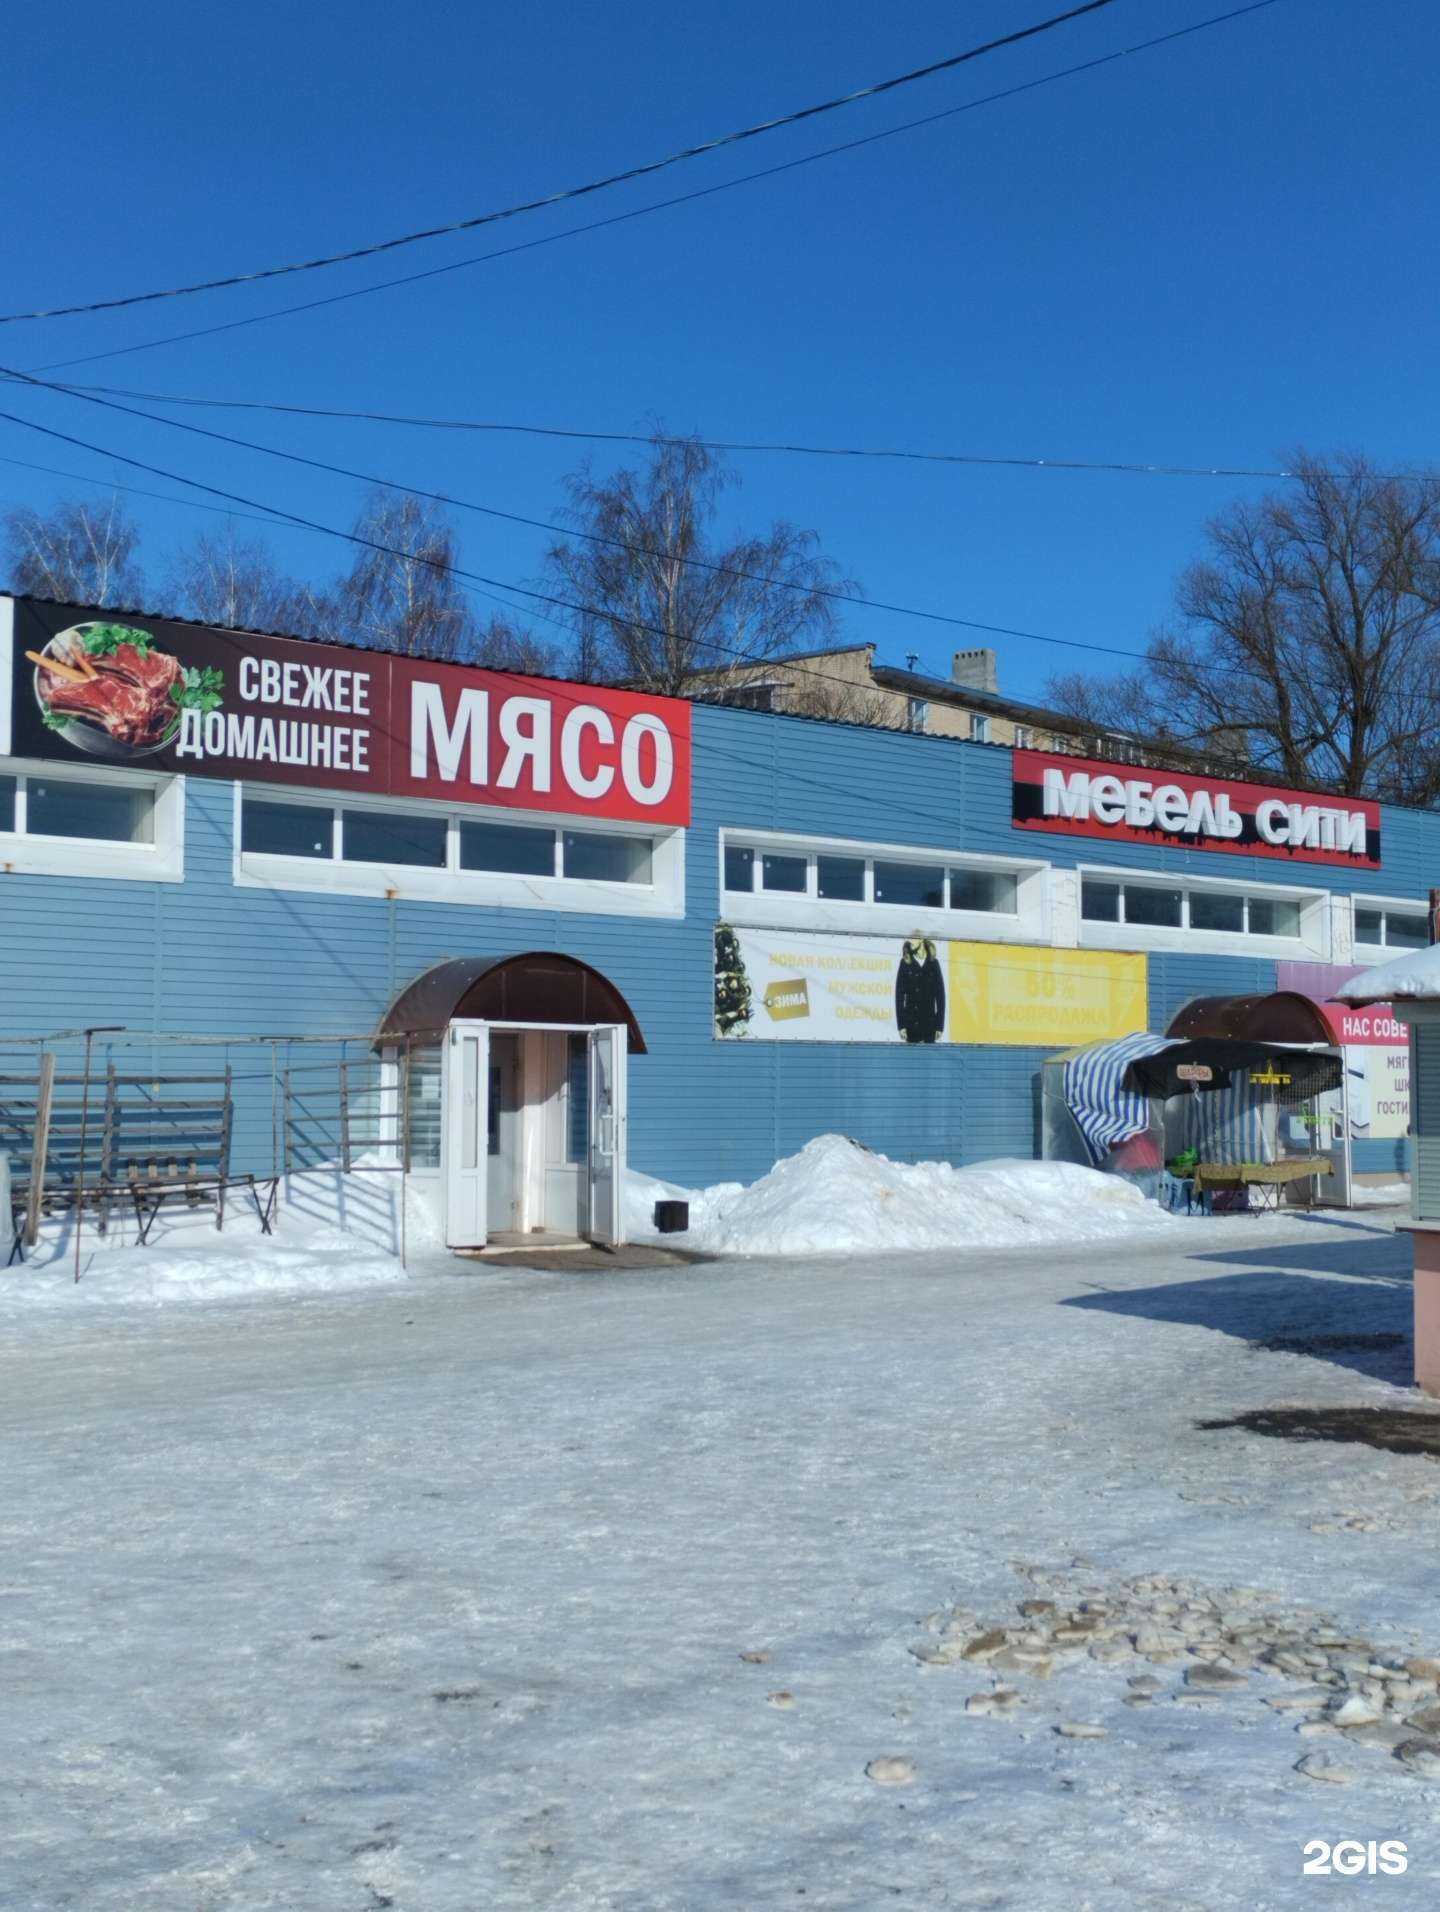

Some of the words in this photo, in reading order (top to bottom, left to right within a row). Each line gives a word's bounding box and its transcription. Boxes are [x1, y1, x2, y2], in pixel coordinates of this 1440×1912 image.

[239, 656, 371, 716] СВЕЖЕЕ
[176, 707, 370, 774] ДОМАШНЕЕ
[410, 680, 674, 806] МЯСО
[1255, 799, 1367, 854] СИТИ
[773, 992, 808, 1009] ЗИМА
[1343, 1016, 1371, 1037] НАС
